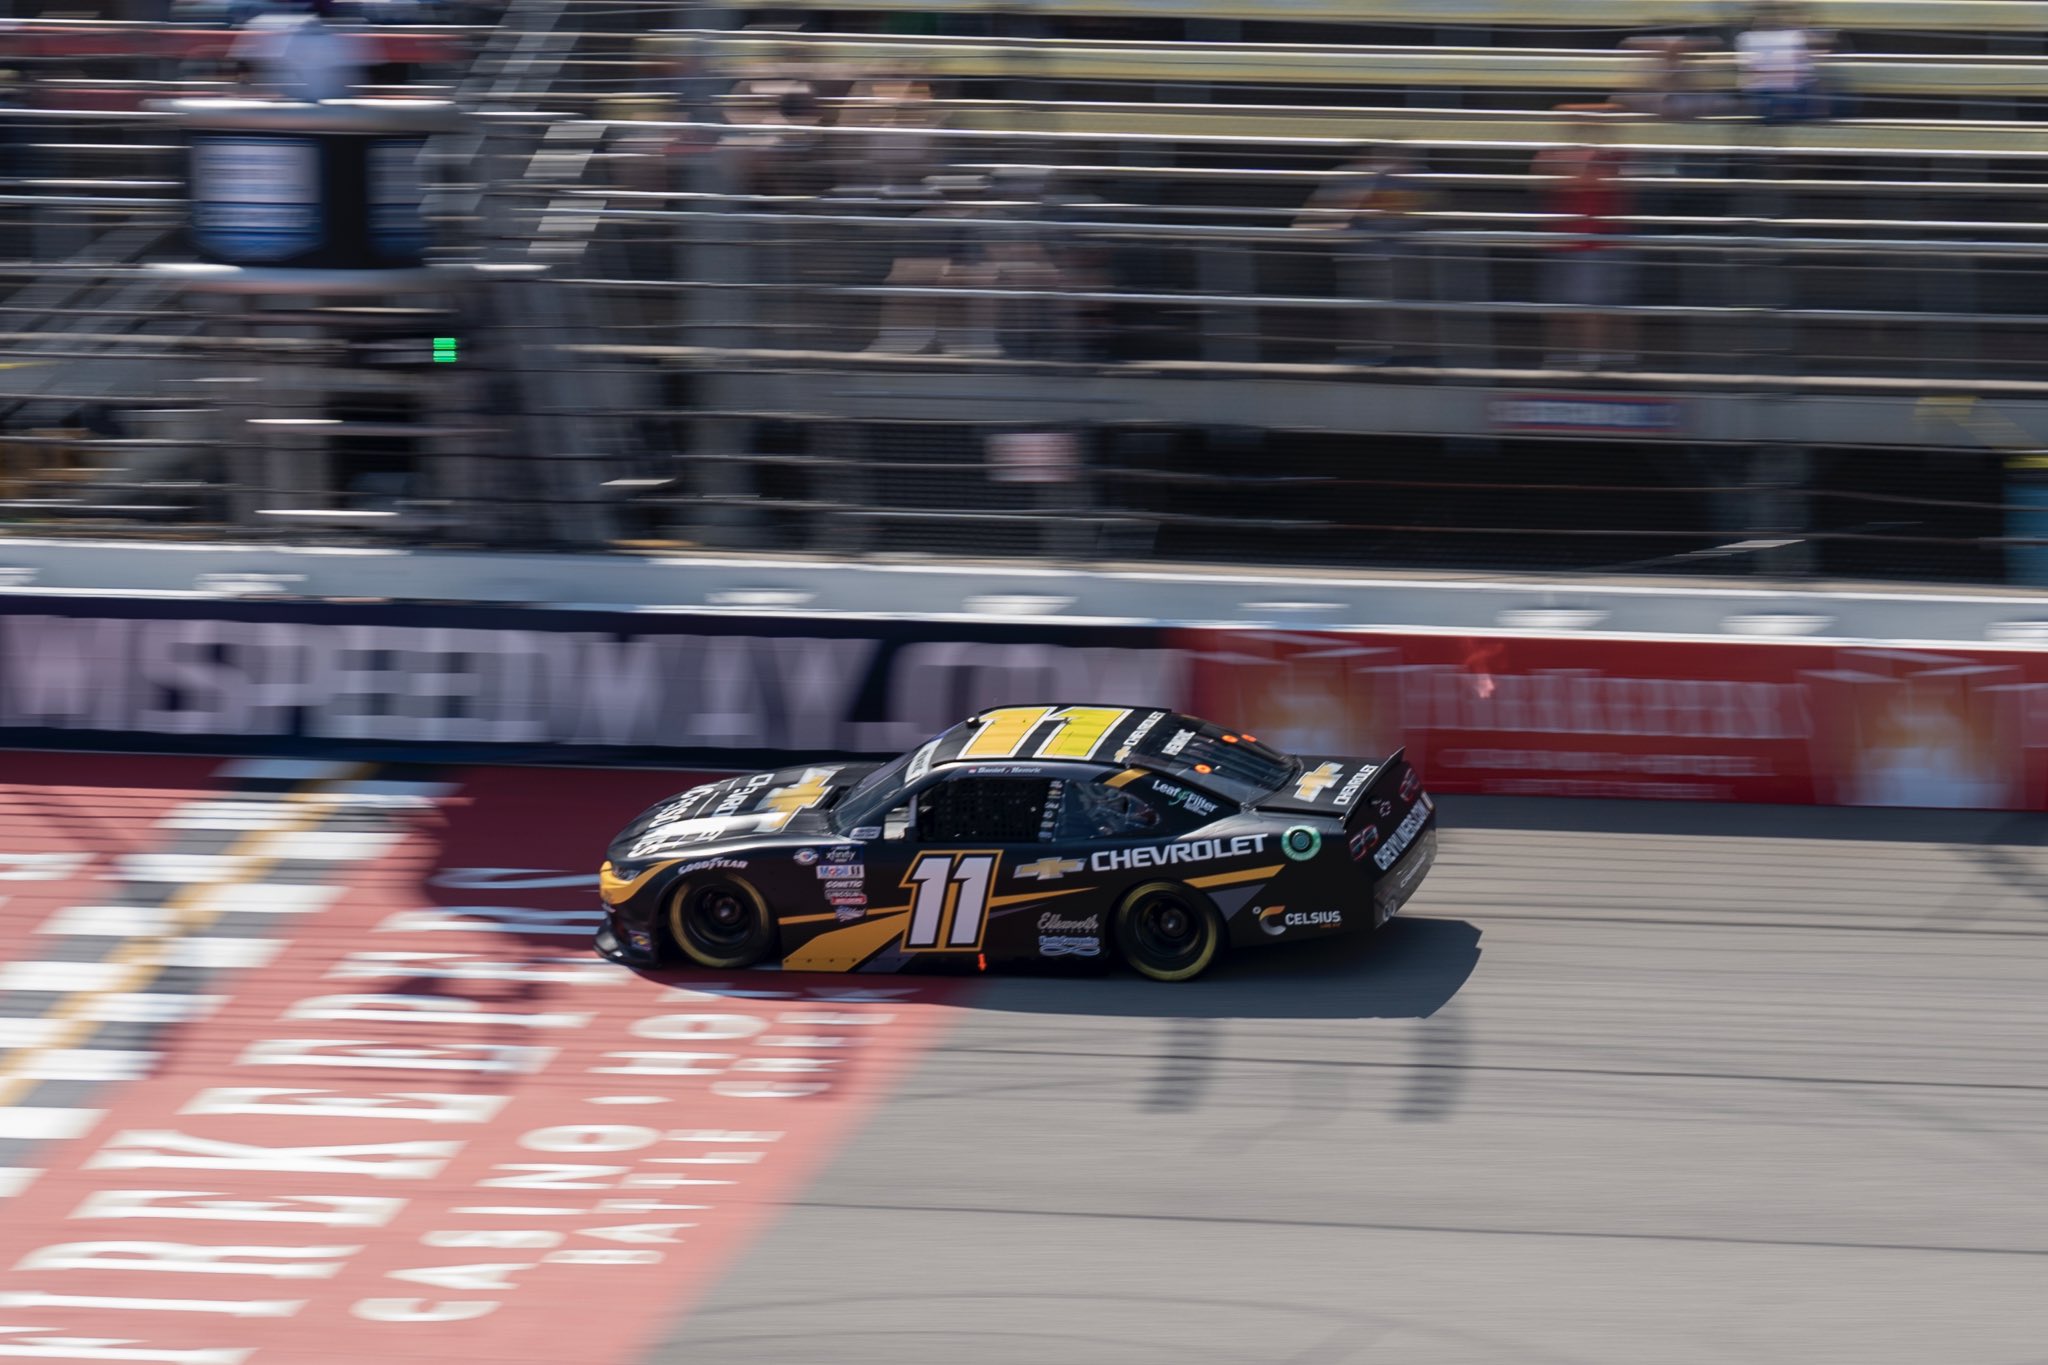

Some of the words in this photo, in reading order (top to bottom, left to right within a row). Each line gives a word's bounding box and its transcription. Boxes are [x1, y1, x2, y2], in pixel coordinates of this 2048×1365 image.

[956, 707, 1135, 760] 11
[678, 857, 749, 875] GOODYEAR
[1091, 833, 1268, 872] CHEVROLET
[903, 853, 998, 950] 11
[1285, 911, 1342, 925] CELSIUS
[350, 1124, 663, 1321] CASINO
[540, 1128, 788, 1265] BATTLE
